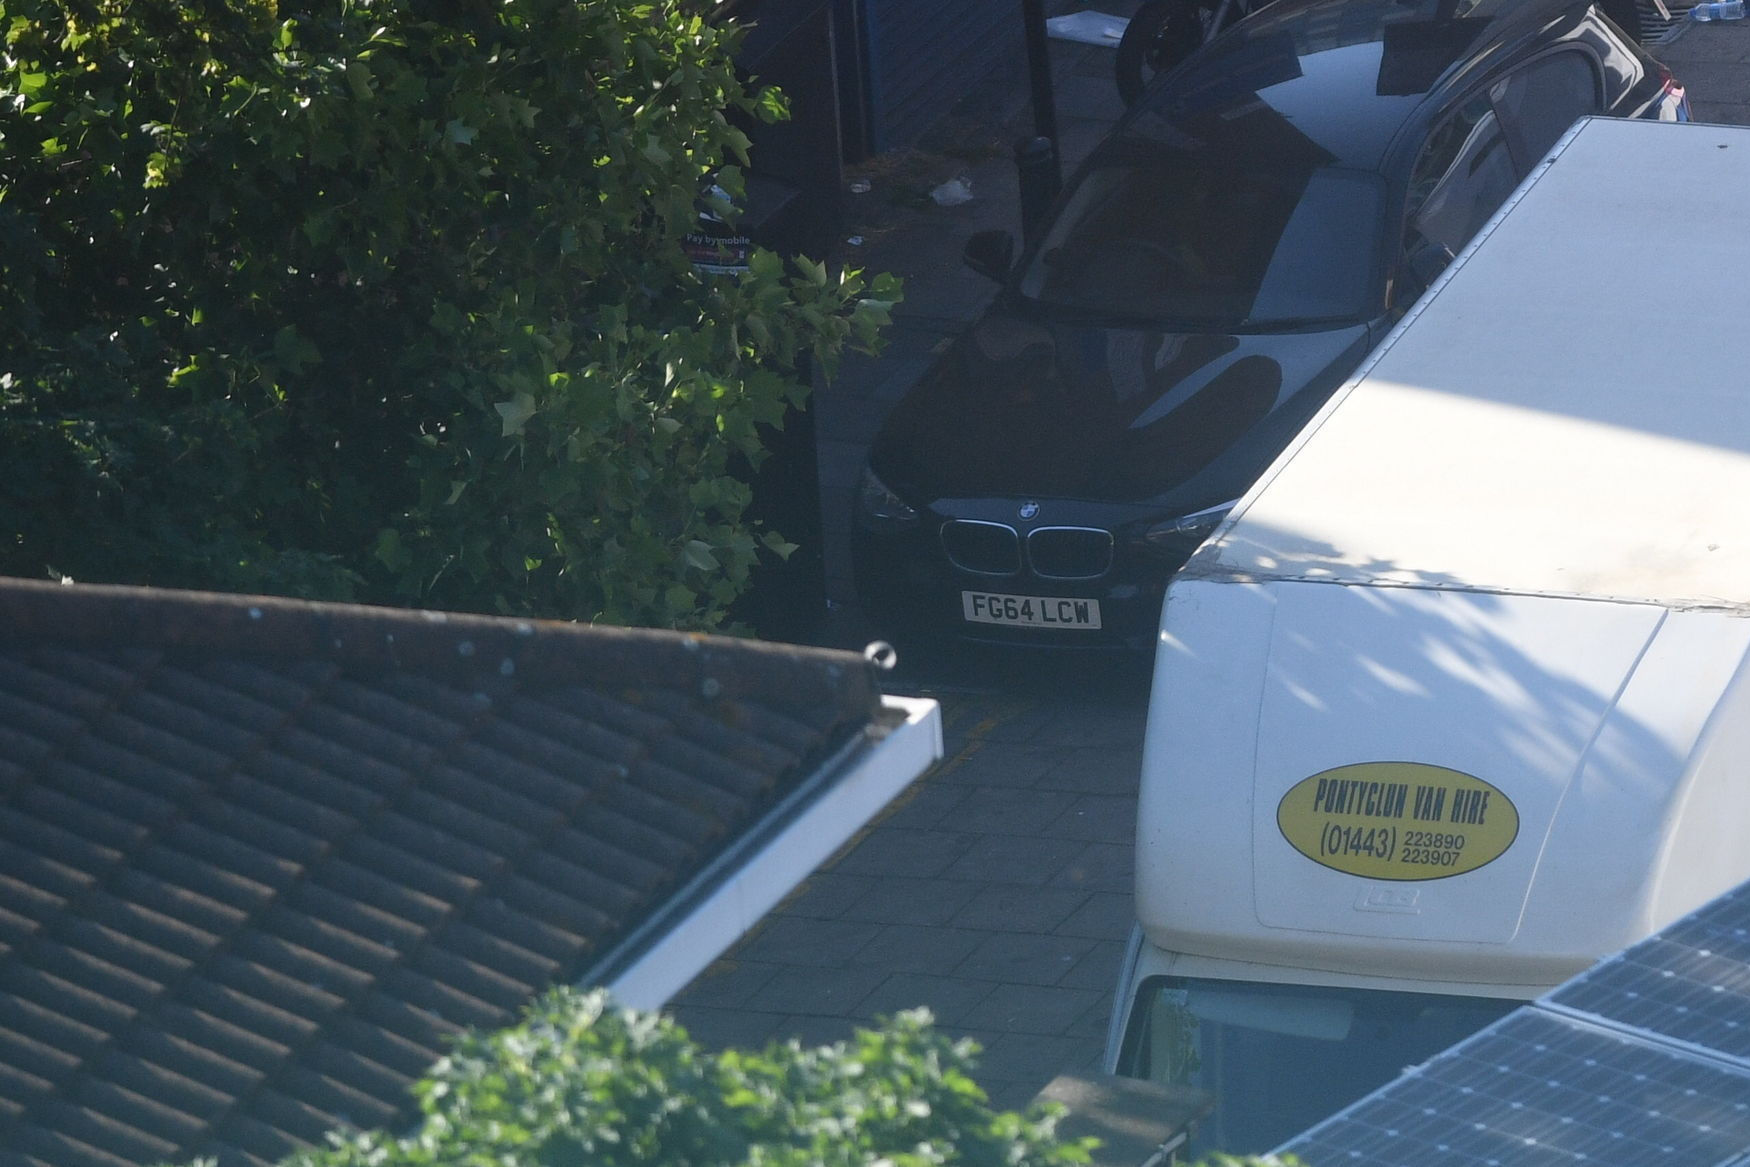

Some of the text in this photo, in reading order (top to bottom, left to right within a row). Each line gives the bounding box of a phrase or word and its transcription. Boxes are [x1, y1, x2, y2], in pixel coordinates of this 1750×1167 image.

[686, 234, 751, 246] Pay by mobile
[972, 595, 1090, 623] FG64 LCW
[1313, 778, 1491, 825] PONTYCLUN VAN HIRE
[1320, 821, 1465, 862] (01443) 223890
[1401, 848, 1461, 867] 223907
